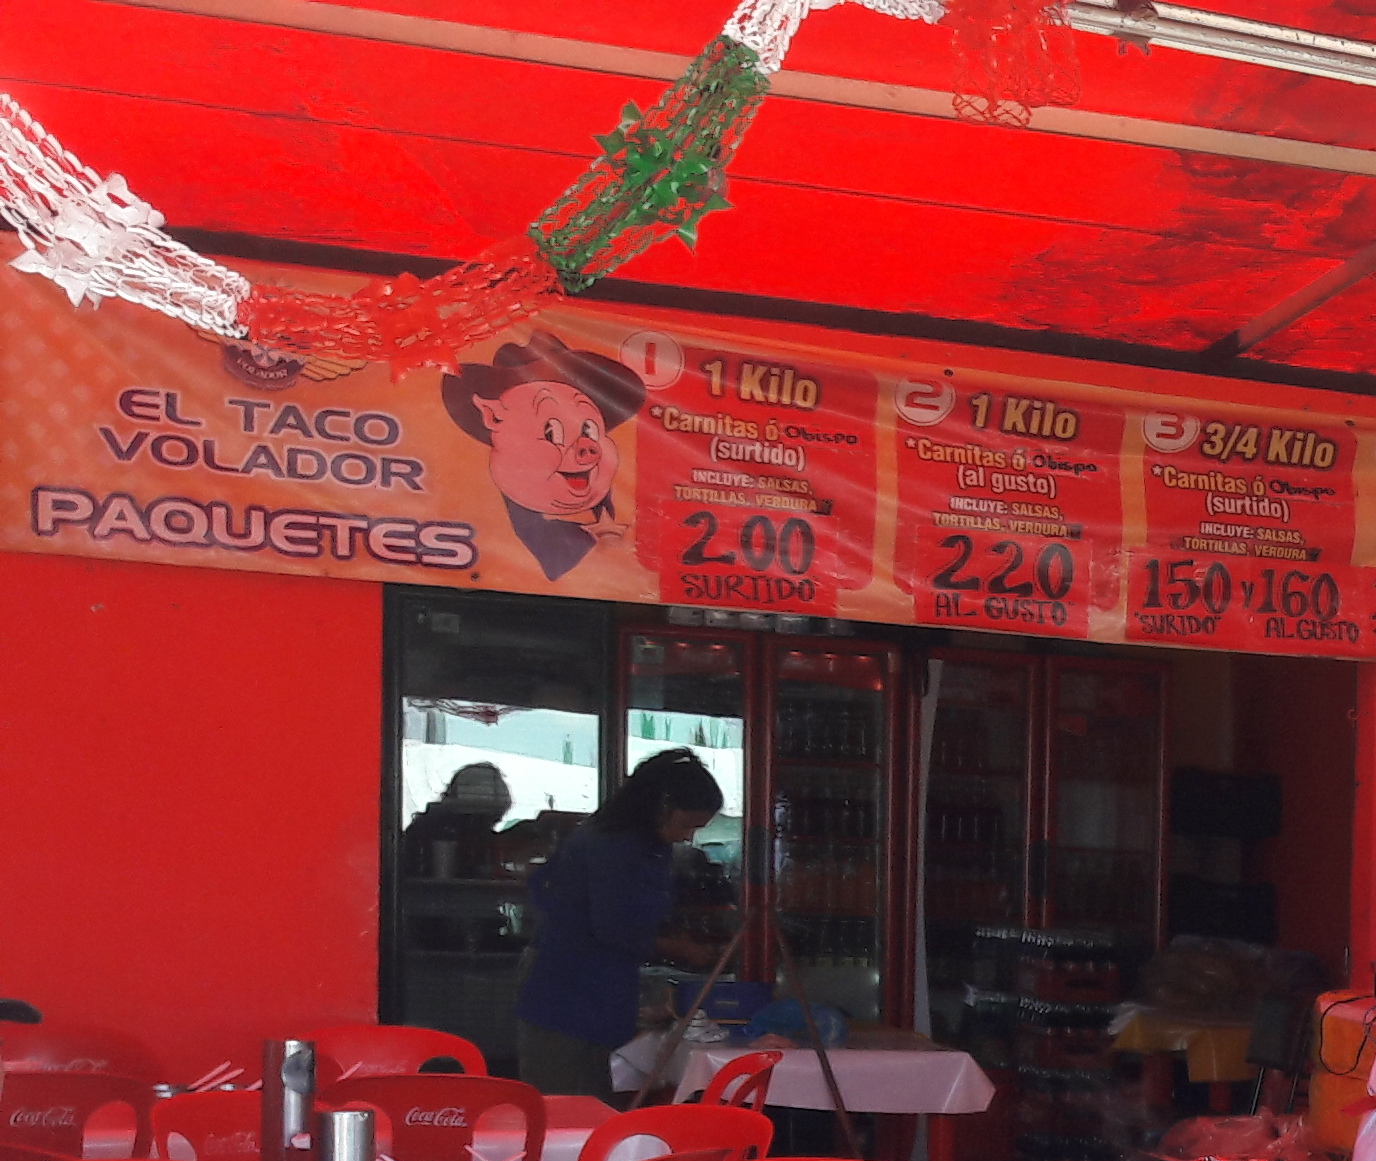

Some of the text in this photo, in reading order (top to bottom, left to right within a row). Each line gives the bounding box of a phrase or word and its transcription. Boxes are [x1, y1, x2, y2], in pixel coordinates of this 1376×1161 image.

[704, 360, 818, 409] 1 Kilo
[906, 387, 940, 412] 2
[118, 388, 401, 448] EL TACO
[971, 392, 1078, 440] 1 Kilo
[1156, 412, 1185, 440] 3
[100, 427, 426, 491] VOLADOR
[710, 436, 805, 471] (surtido)
[1201, 422, 1335, 468] 3/4 Kilo
[756, 493, 818, 512] VERDURA
[993, 469, 1057, 499] gusto)
[1206, 492, 1290, 522] (surtido)
[31, 486, 479, 570] PAQUETES
[1009, 519, 1068, 538] VERDURA
[932, 535, 1074, 600] 220
[1255, 544, 1307, 560] VERDURA
[1143, 559, 1340, 620] 150 160
